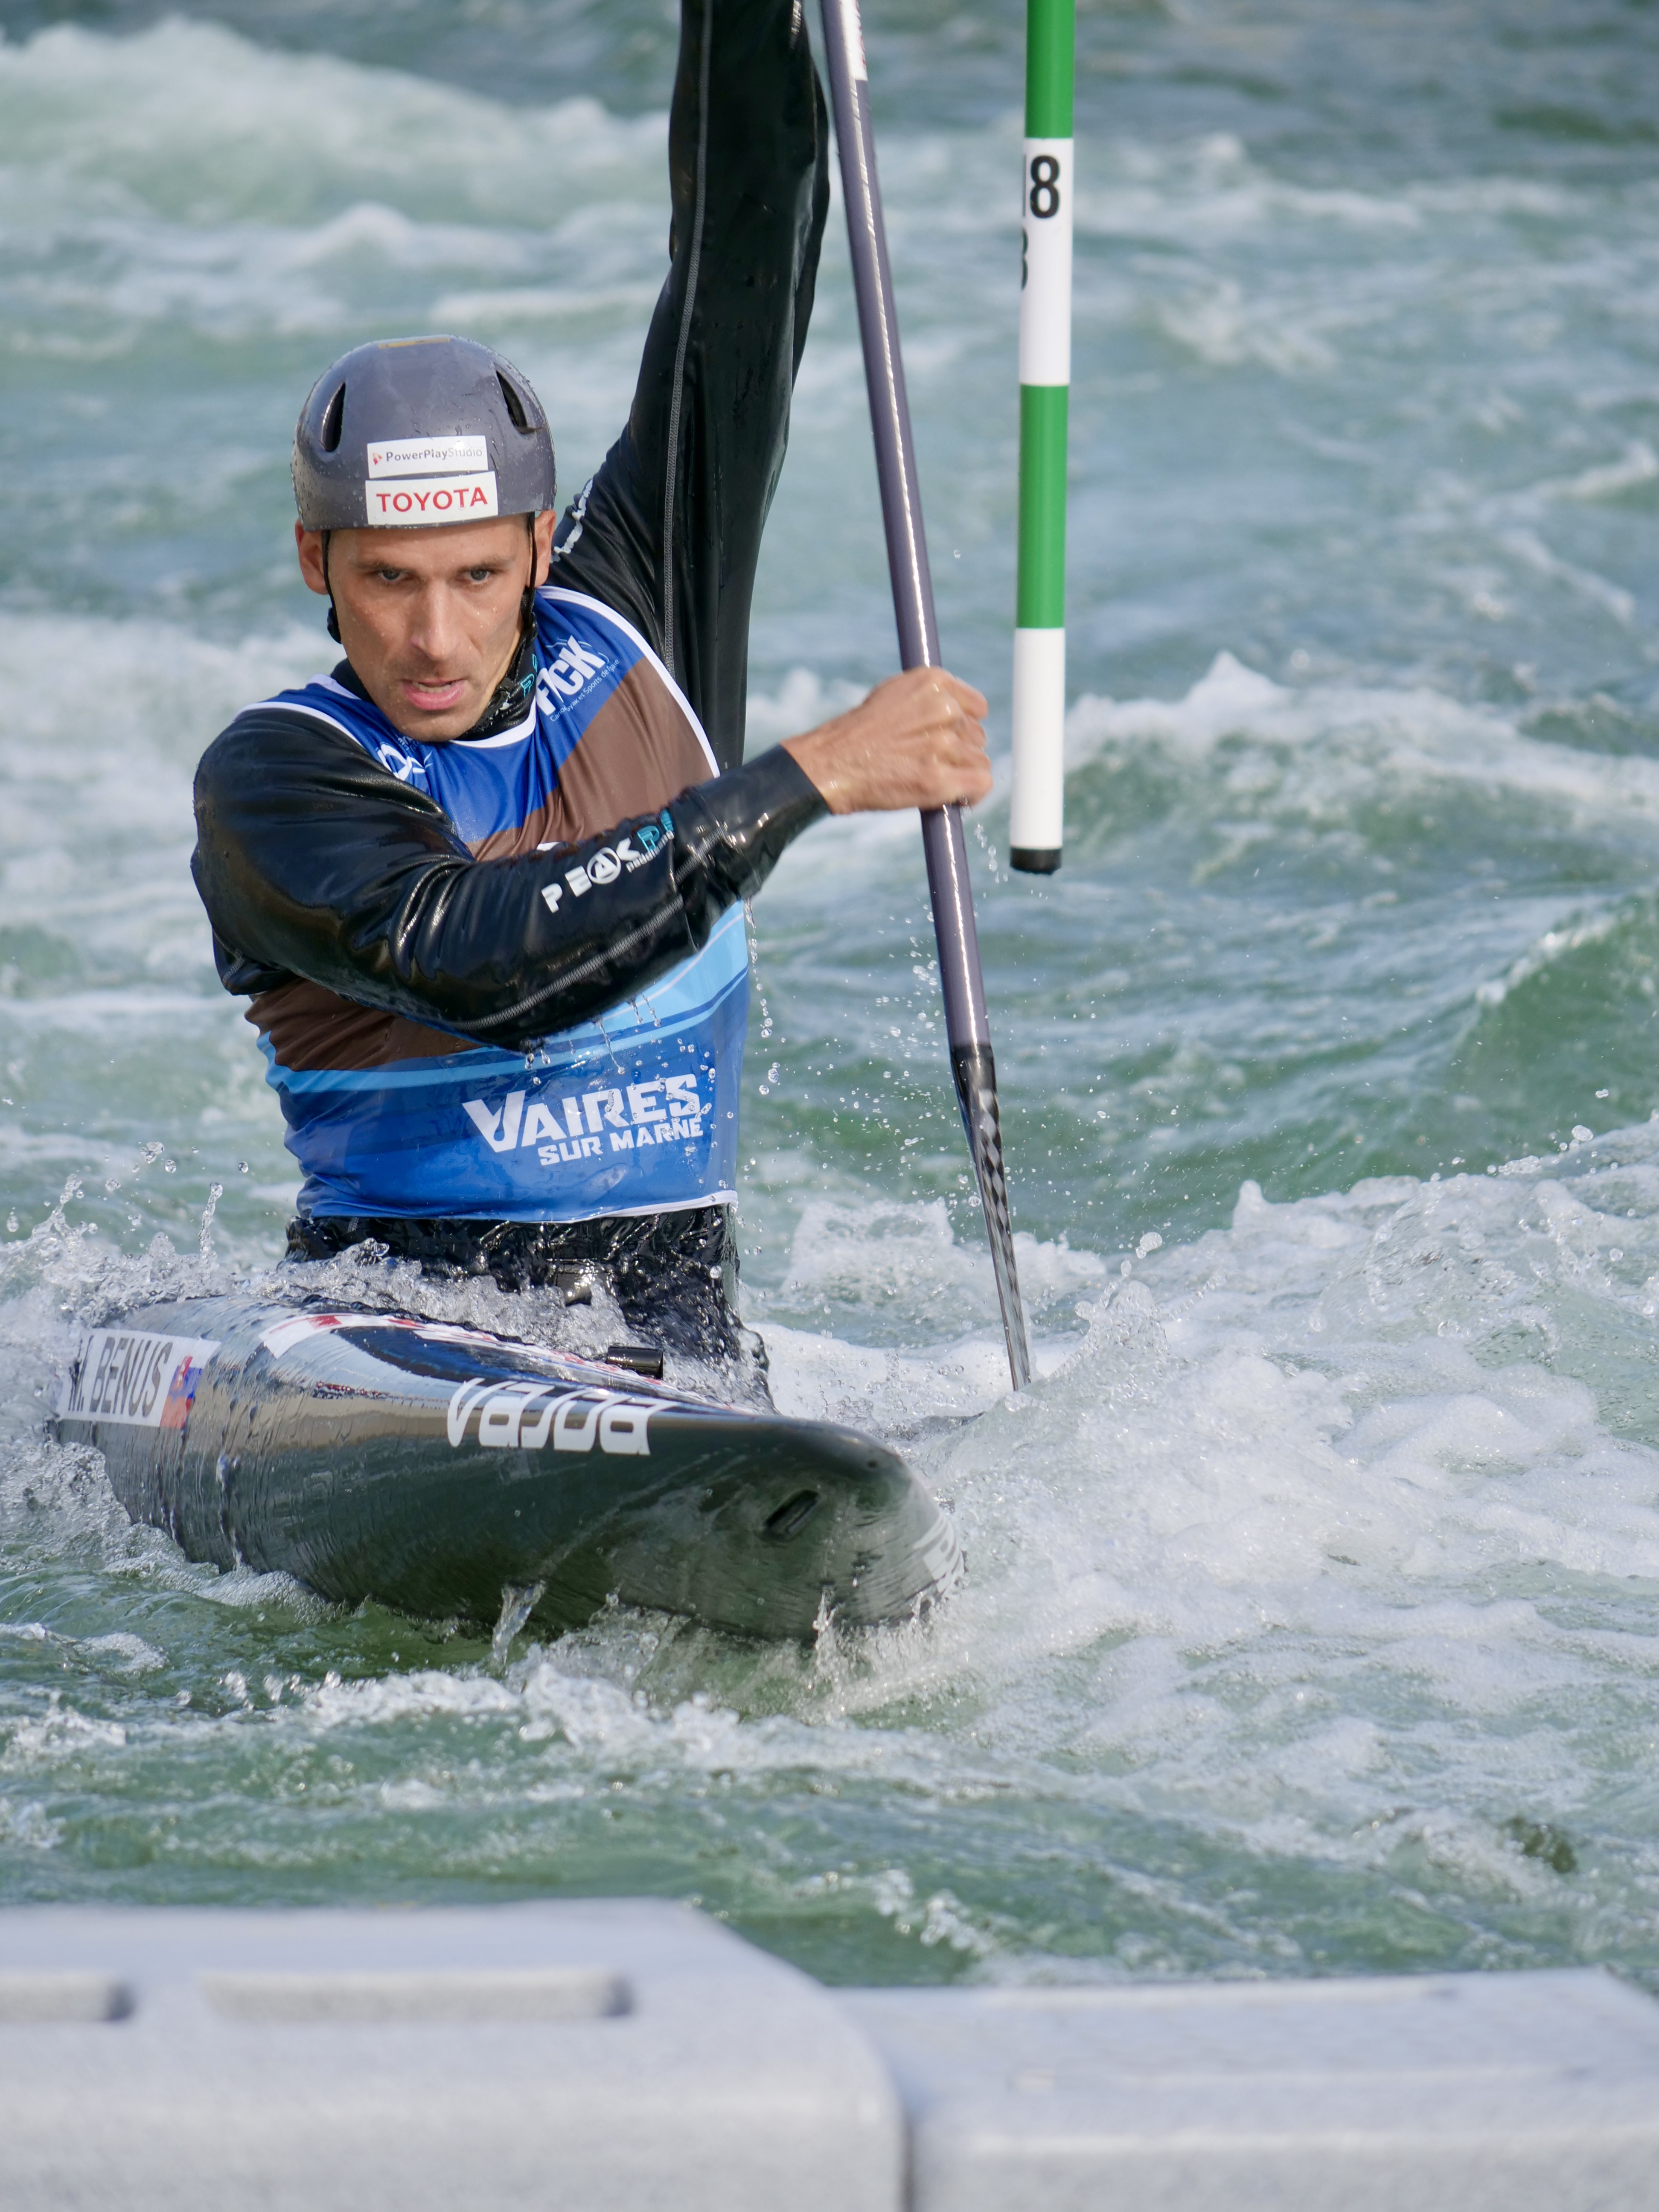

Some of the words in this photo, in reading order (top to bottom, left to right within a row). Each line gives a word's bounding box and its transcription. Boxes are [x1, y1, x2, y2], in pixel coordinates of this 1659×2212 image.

[1024, 154, 1061, 219] 8
[386, 447, 483, 462] PowerPlayStudio
[376, 486, 488, 512] TOYOTA
[583, 676, 602, 694] Sports
[601, 669, 609, 678] de
[462, 1074, 700, 1153] VAIRES
[538, 1137, 603, 1166] SUR
[609, 1116, 703, 1152] MARNE
[89, 1336, 173, 1417] BENUS
